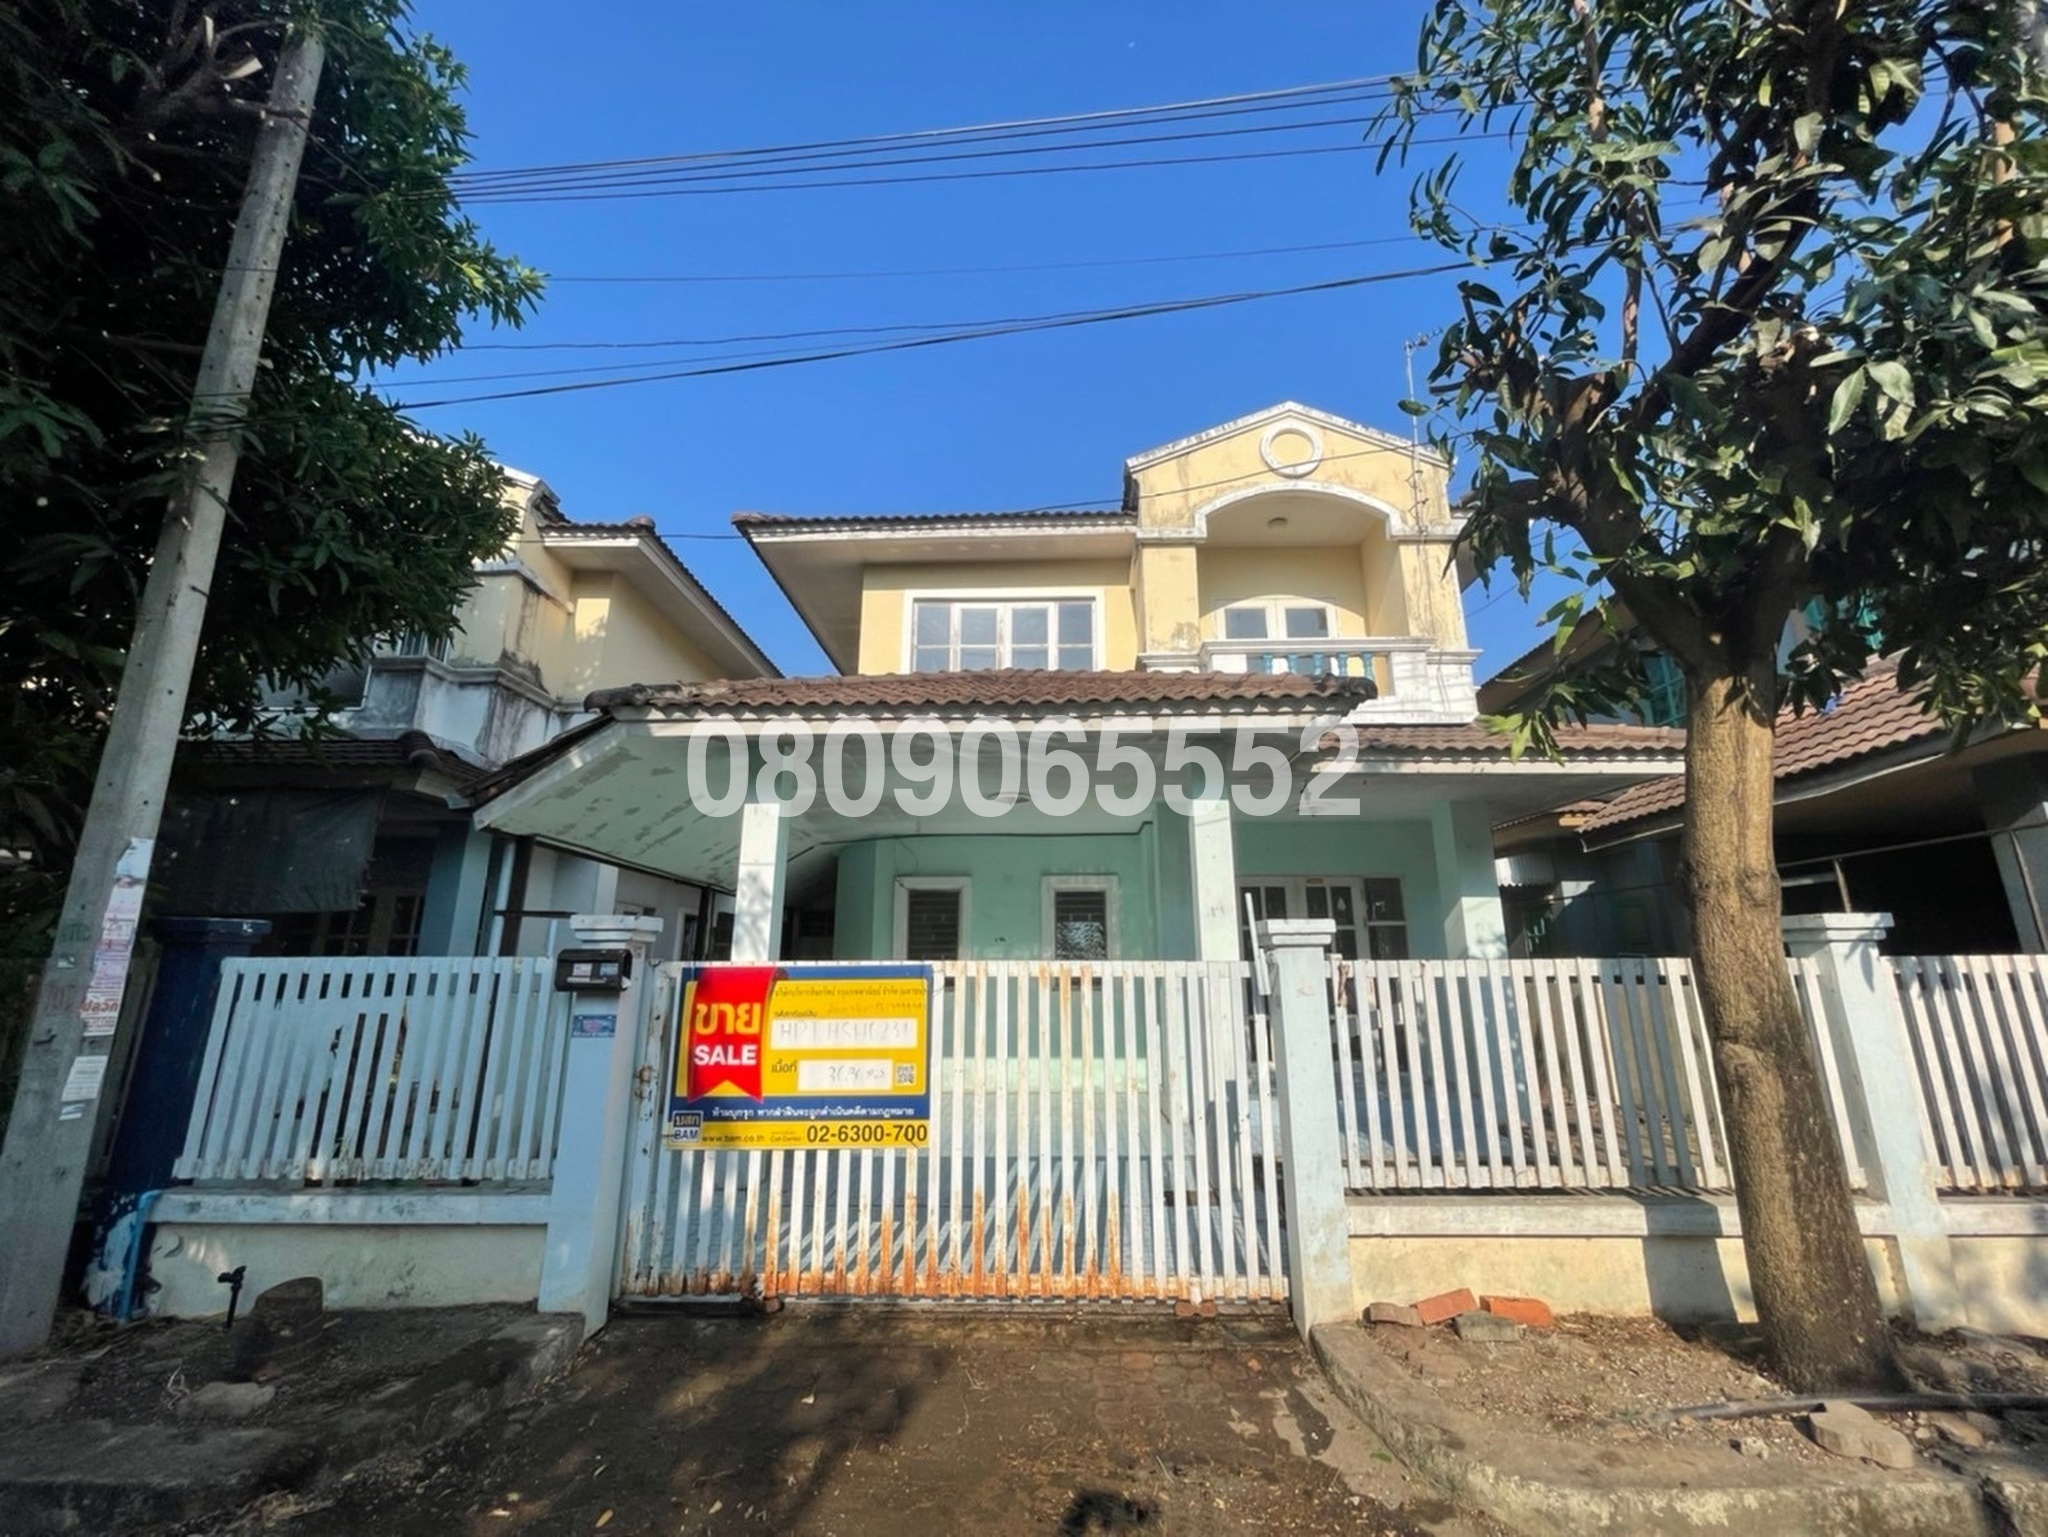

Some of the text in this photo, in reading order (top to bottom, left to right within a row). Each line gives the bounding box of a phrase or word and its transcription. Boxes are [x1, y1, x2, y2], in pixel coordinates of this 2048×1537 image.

[695, 1003, 761, 1035] ขาย
[694, 1045, 757, 1066] SALE
[674, 1127, 699, 1140] BAM
[702, 1133, 765, 1143] www.bam.co.th
[807, 1124, 928, 1143] 02-6300-700
